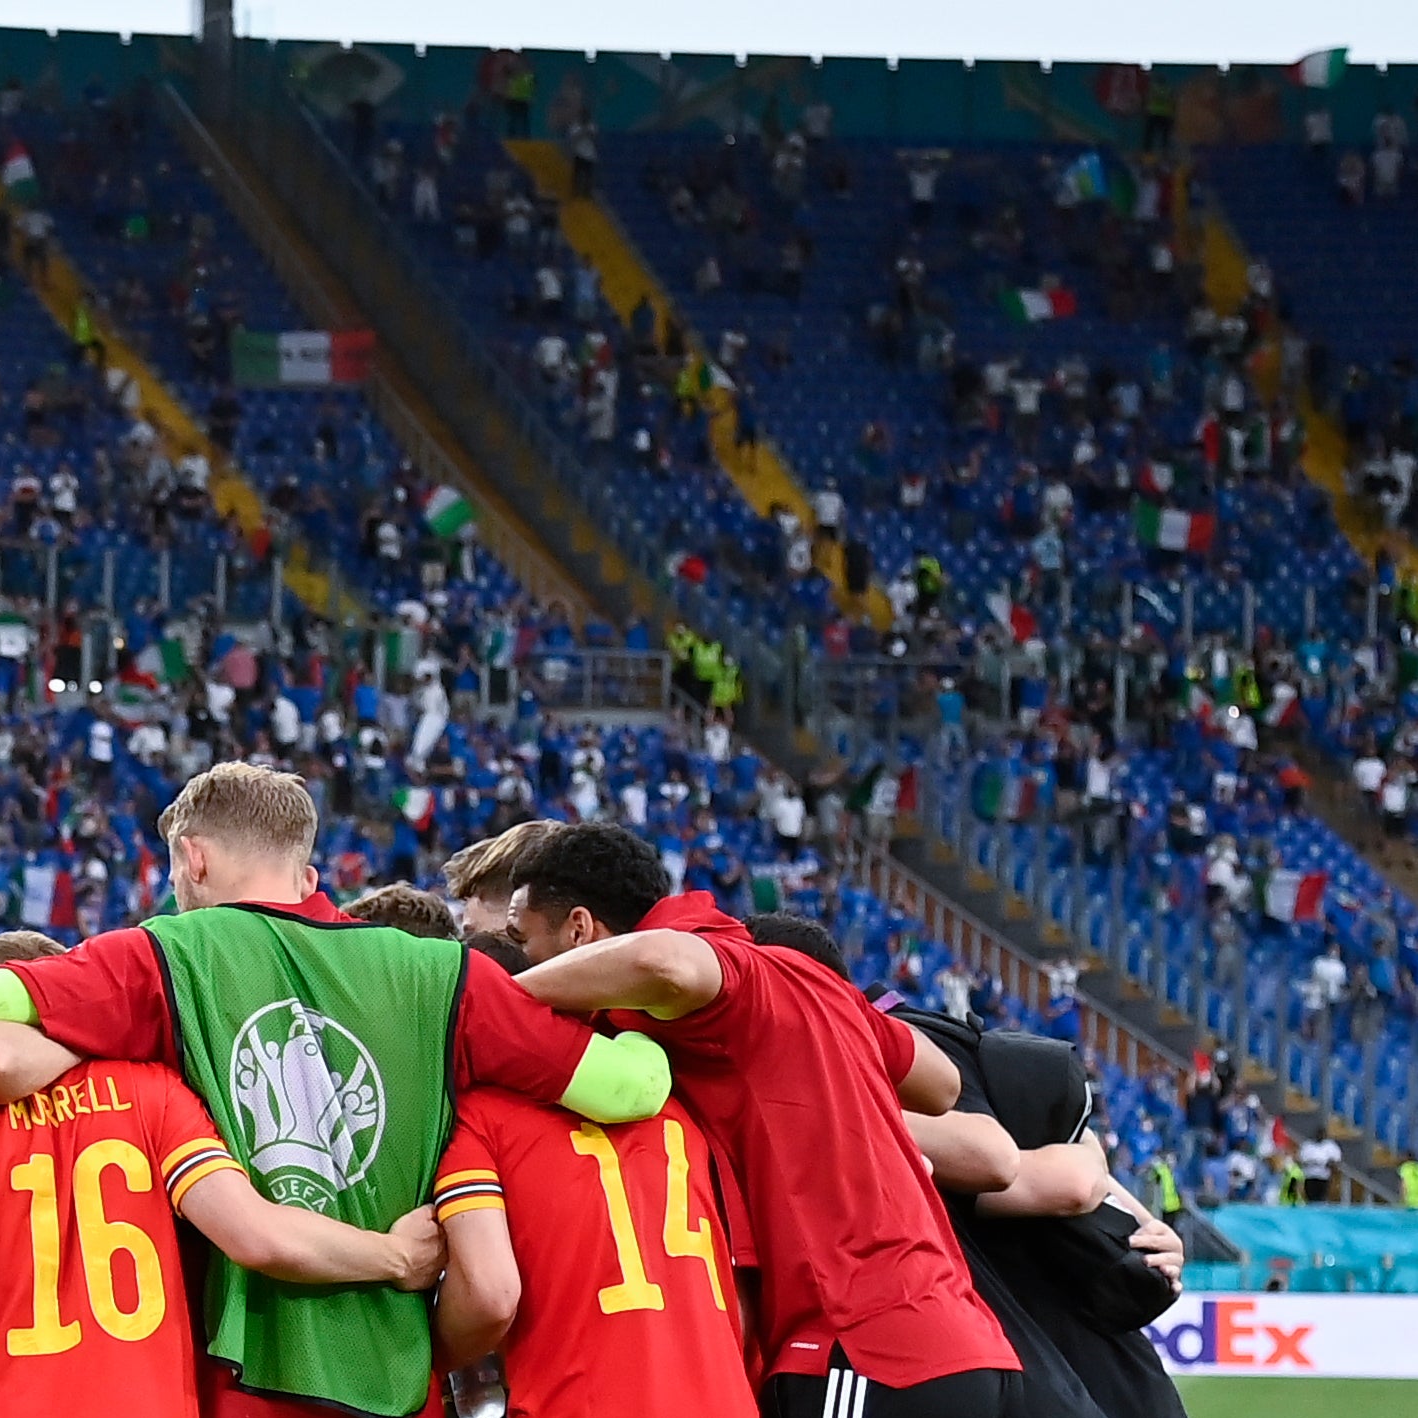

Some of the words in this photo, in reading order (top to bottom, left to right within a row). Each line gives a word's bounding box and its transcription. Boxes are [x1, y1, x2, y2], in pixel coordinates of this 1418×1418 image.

[7, 1140, 166, 1356] 16
[271, 1180, 328, 1213] UEFA
[570, 1119, 727, 1314] 14
